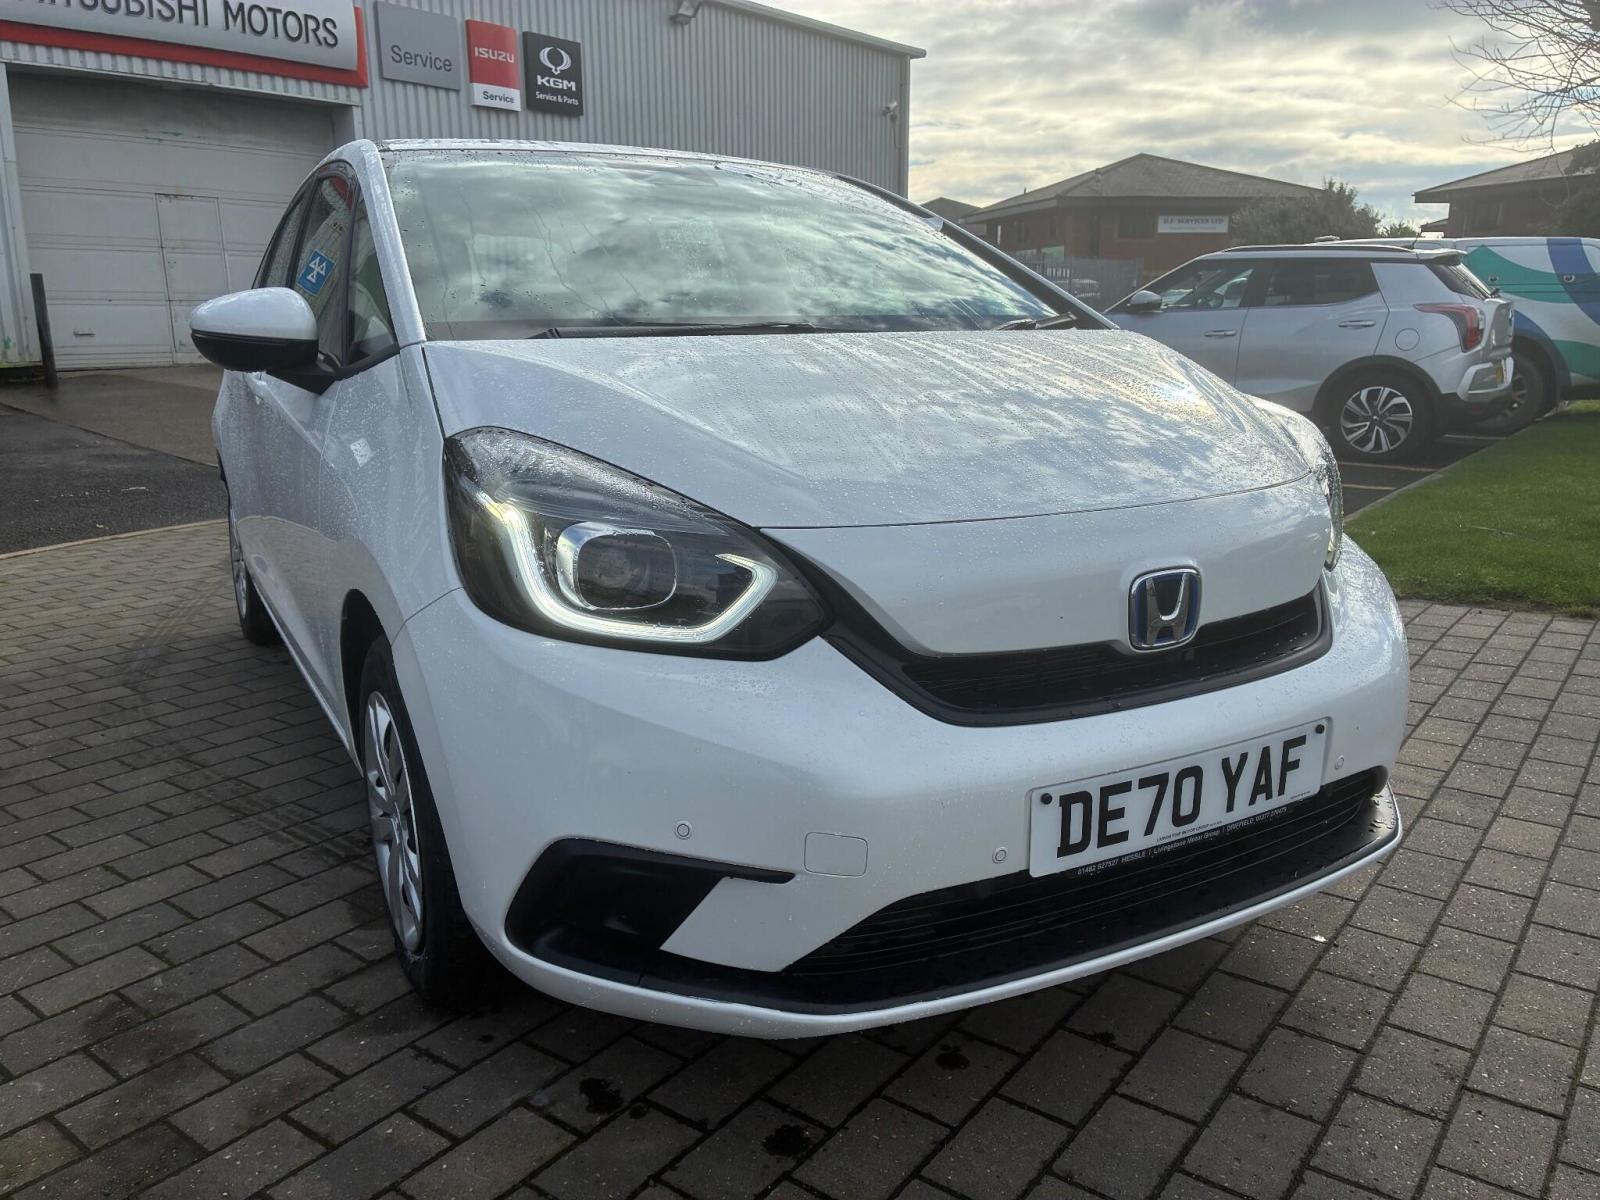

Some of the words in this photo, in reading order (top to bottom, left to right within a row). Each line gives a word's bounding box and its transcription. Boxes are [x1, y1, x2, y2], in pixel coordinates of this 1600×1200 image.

[20, 0, 209, 27] BISHI
[223, 0, 338, 48] MOTORS
[391, 44, 453, 72] Service
[474, 46, 515, 63] ISUZU
[536, 75, 576, 91] KGM
[482, 90, 515, 104] Service
[535, 91, 557, 102] Service
[563, 95, 579, 106] Parts
[1057, 765, 1204, 858] DE70
[1221, 734, 1307, 813] YAF
